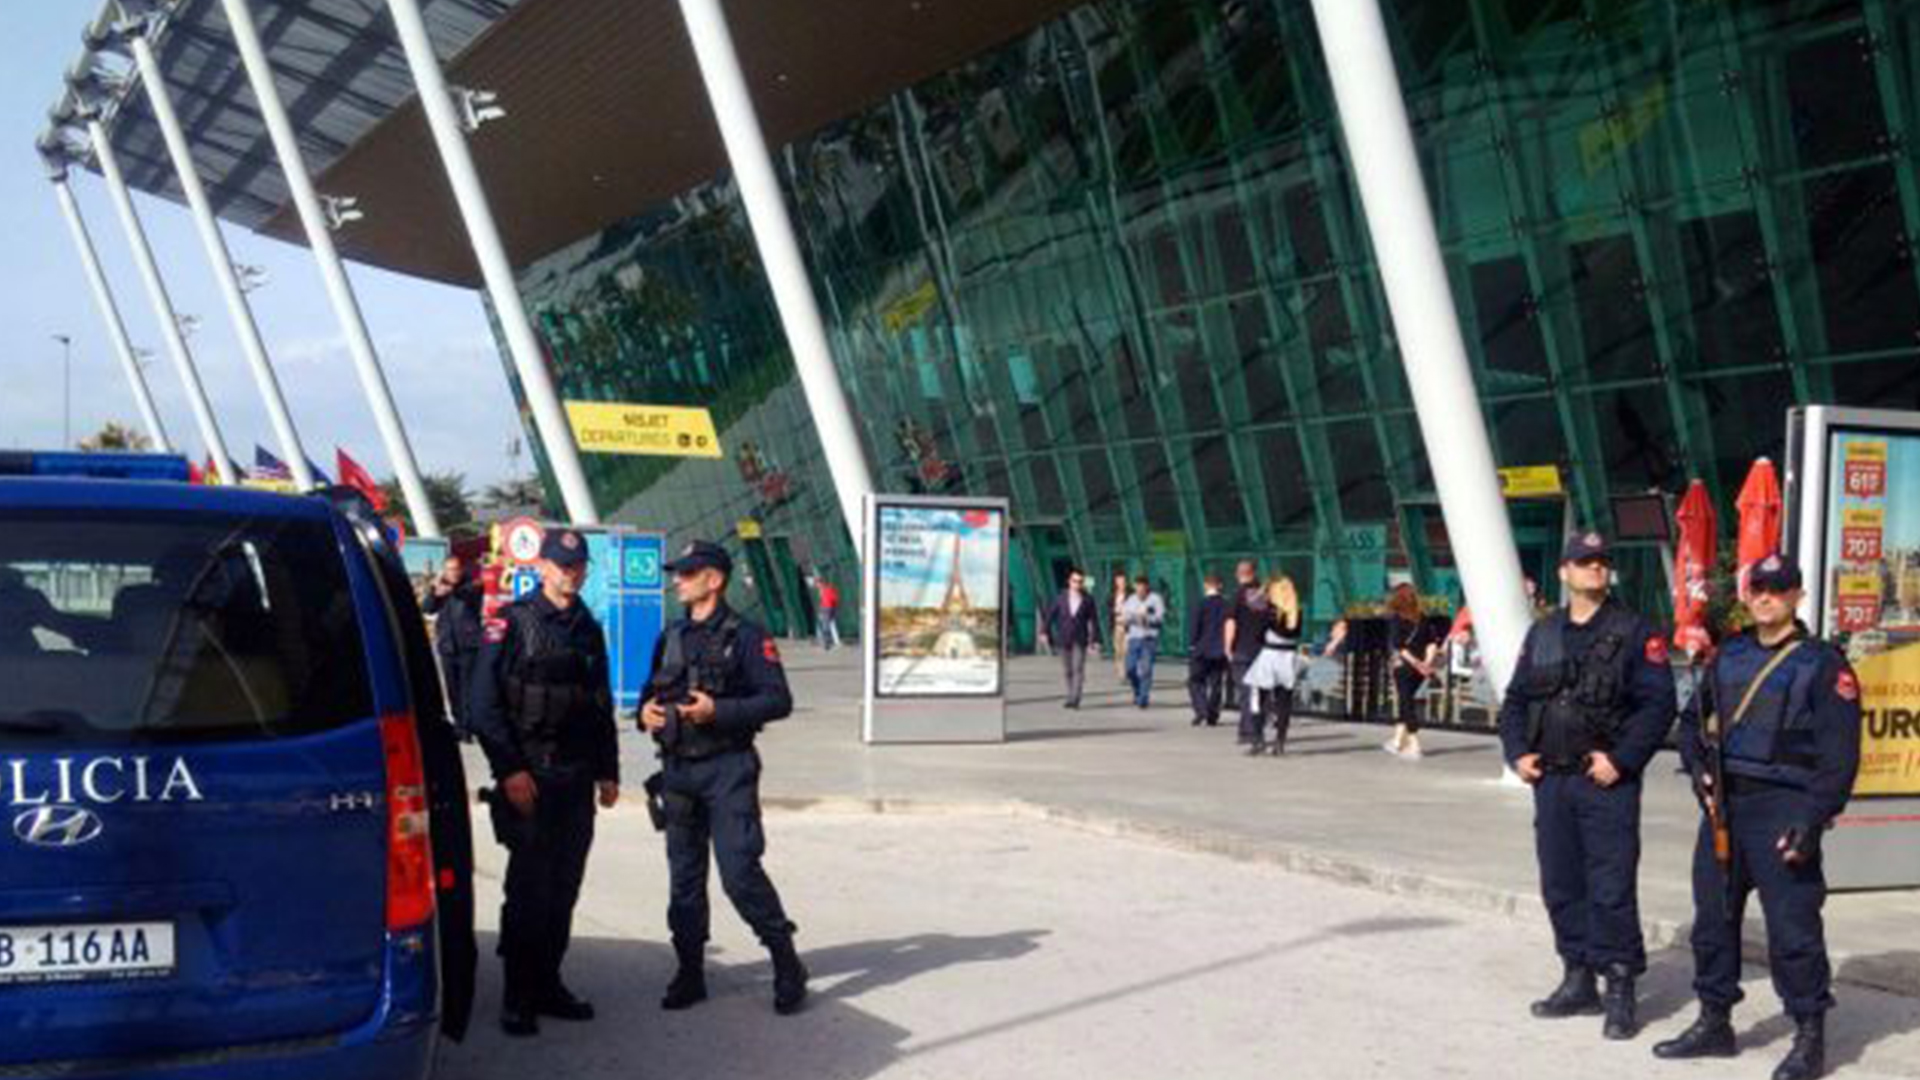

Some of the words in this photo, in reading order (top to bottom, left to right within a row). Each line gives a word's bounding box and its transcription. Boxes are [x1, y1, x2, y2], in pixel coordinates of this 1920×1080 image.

[580, 427, 671, 446] DEPARTURES
[1861, 706, 1920, 740] UR
[0, 756, 204, 806] LICIA
[38, 930, 102, 967] 116
[109, 927, 150, 963] AA
